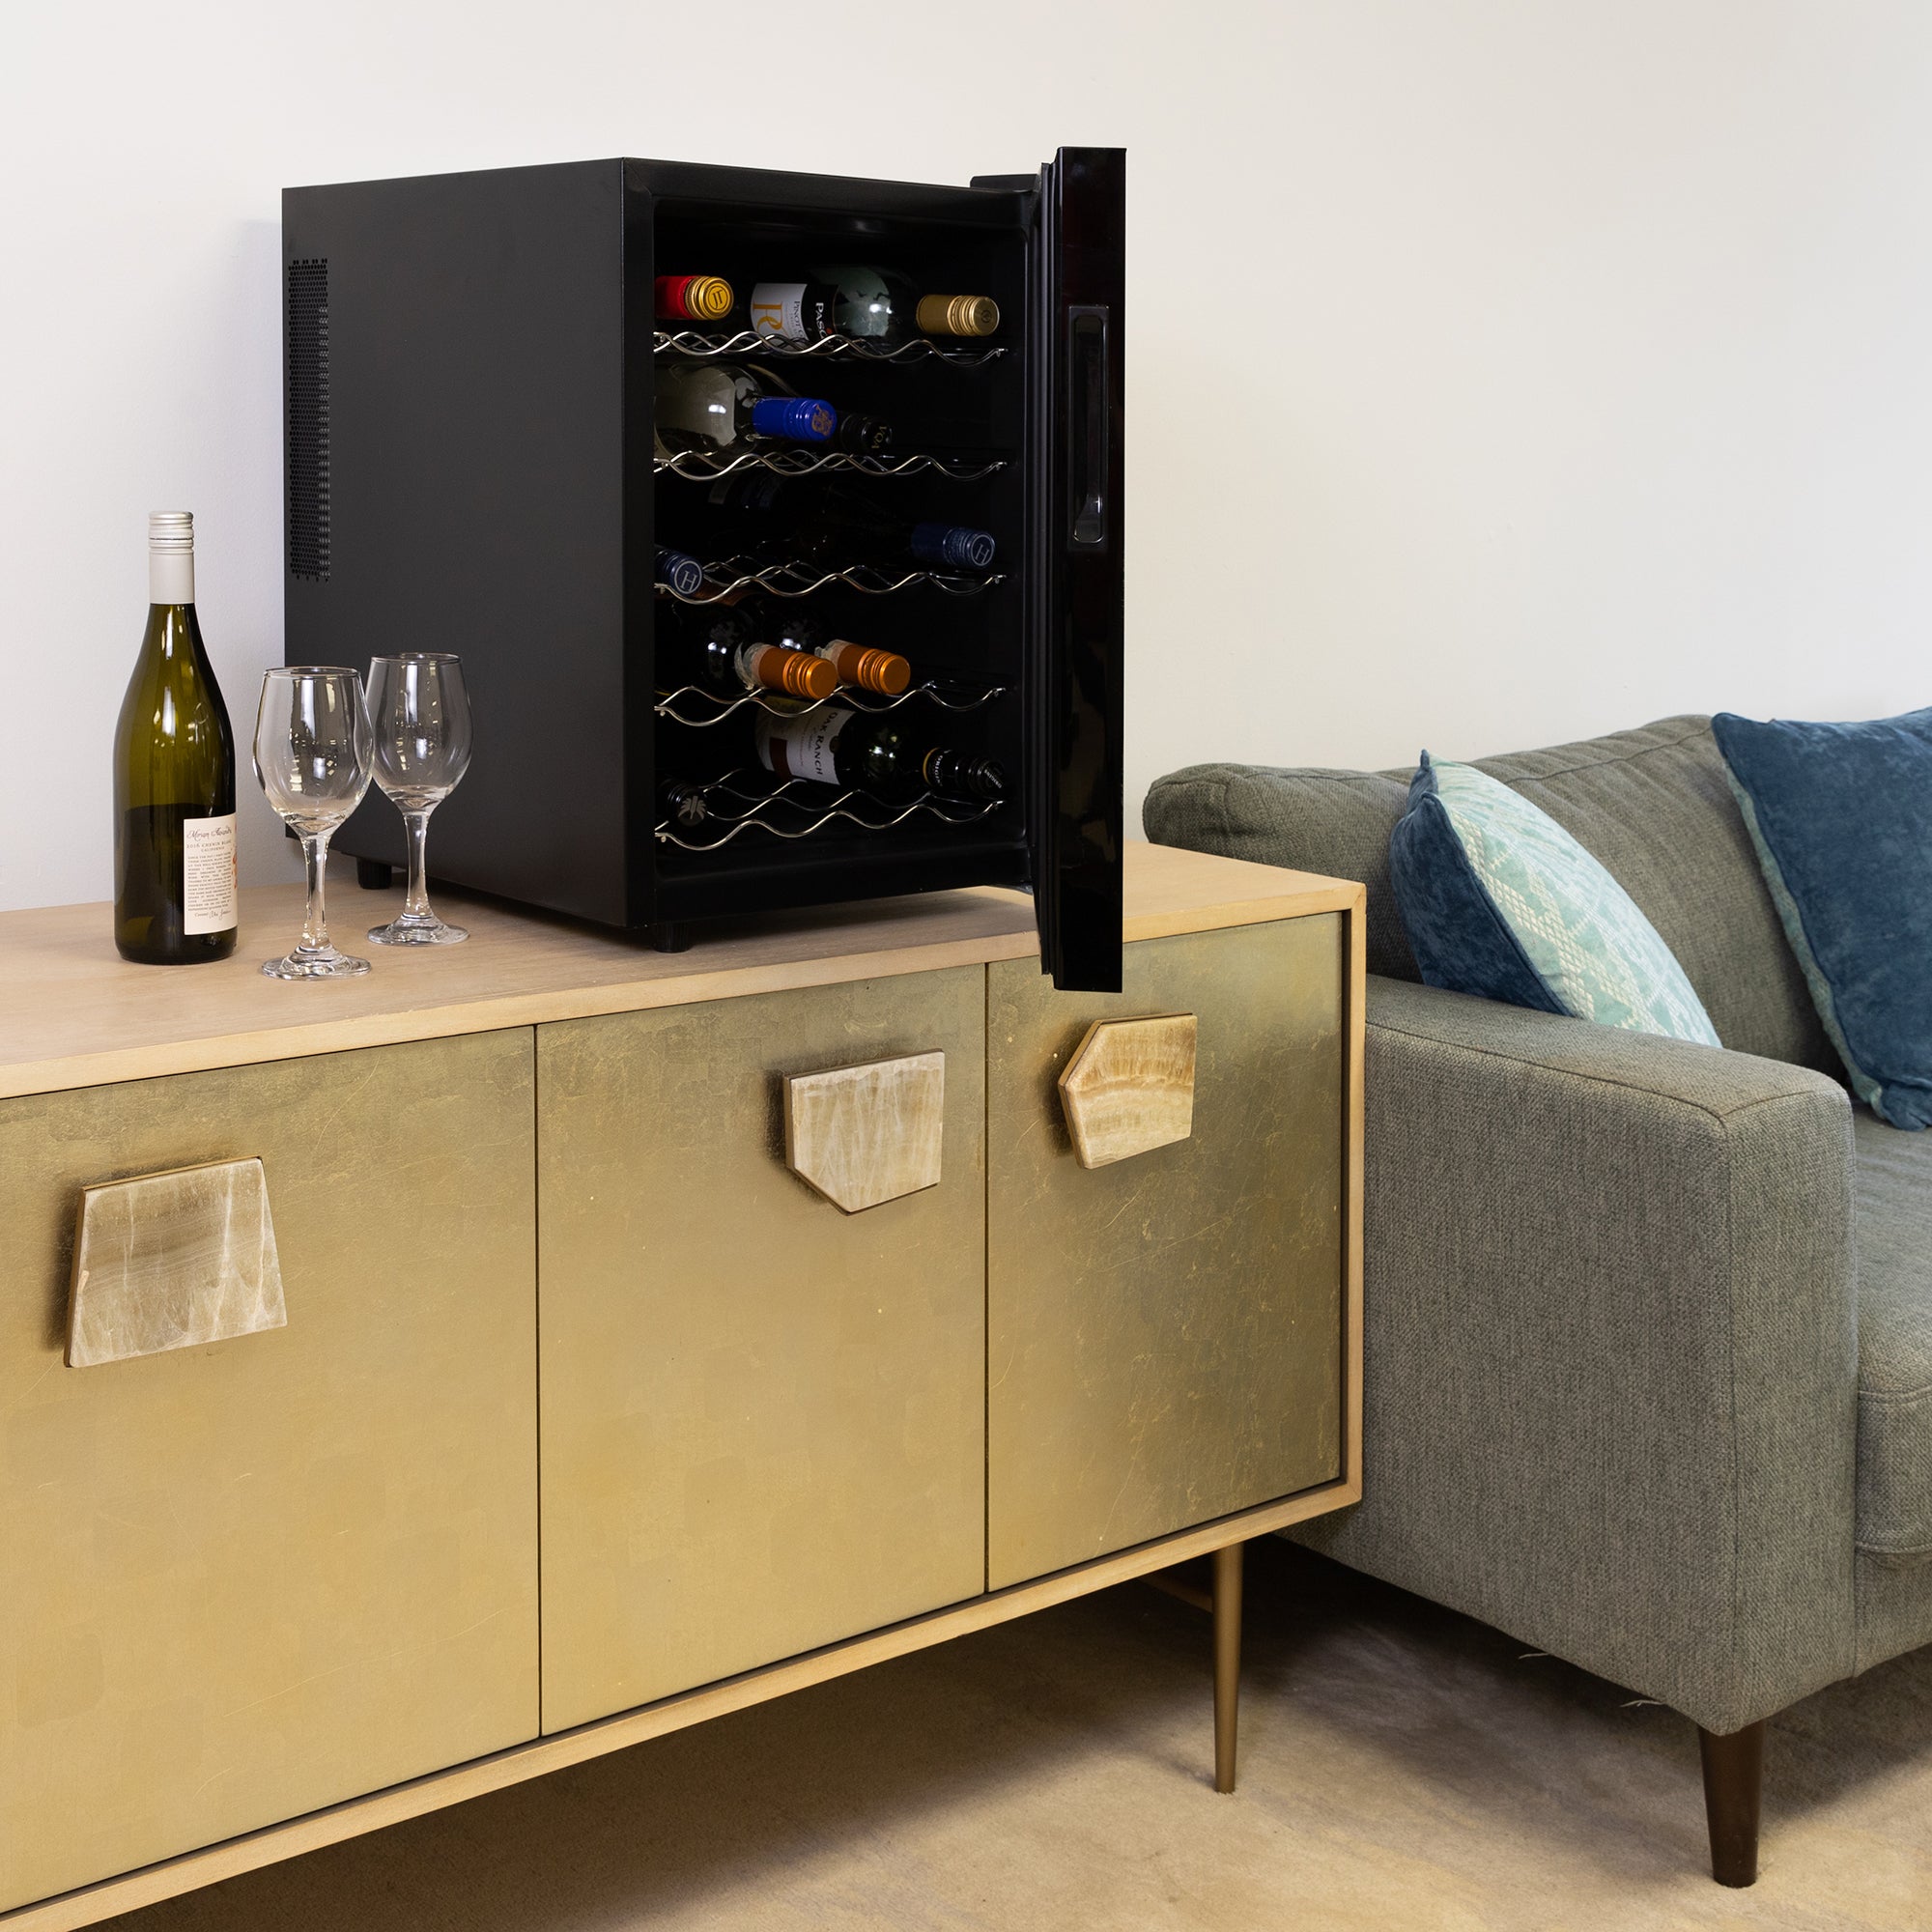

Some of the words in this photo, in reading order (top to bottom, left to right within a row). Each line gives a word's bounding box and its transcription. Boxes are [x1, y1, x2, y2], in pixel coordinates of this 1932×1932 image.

[871, 426, 888, 449] VQA
[680, 570, 697, 591] H
[819, 711, 838, 732] OAK
[814, 735, 825, 776] RANCH
